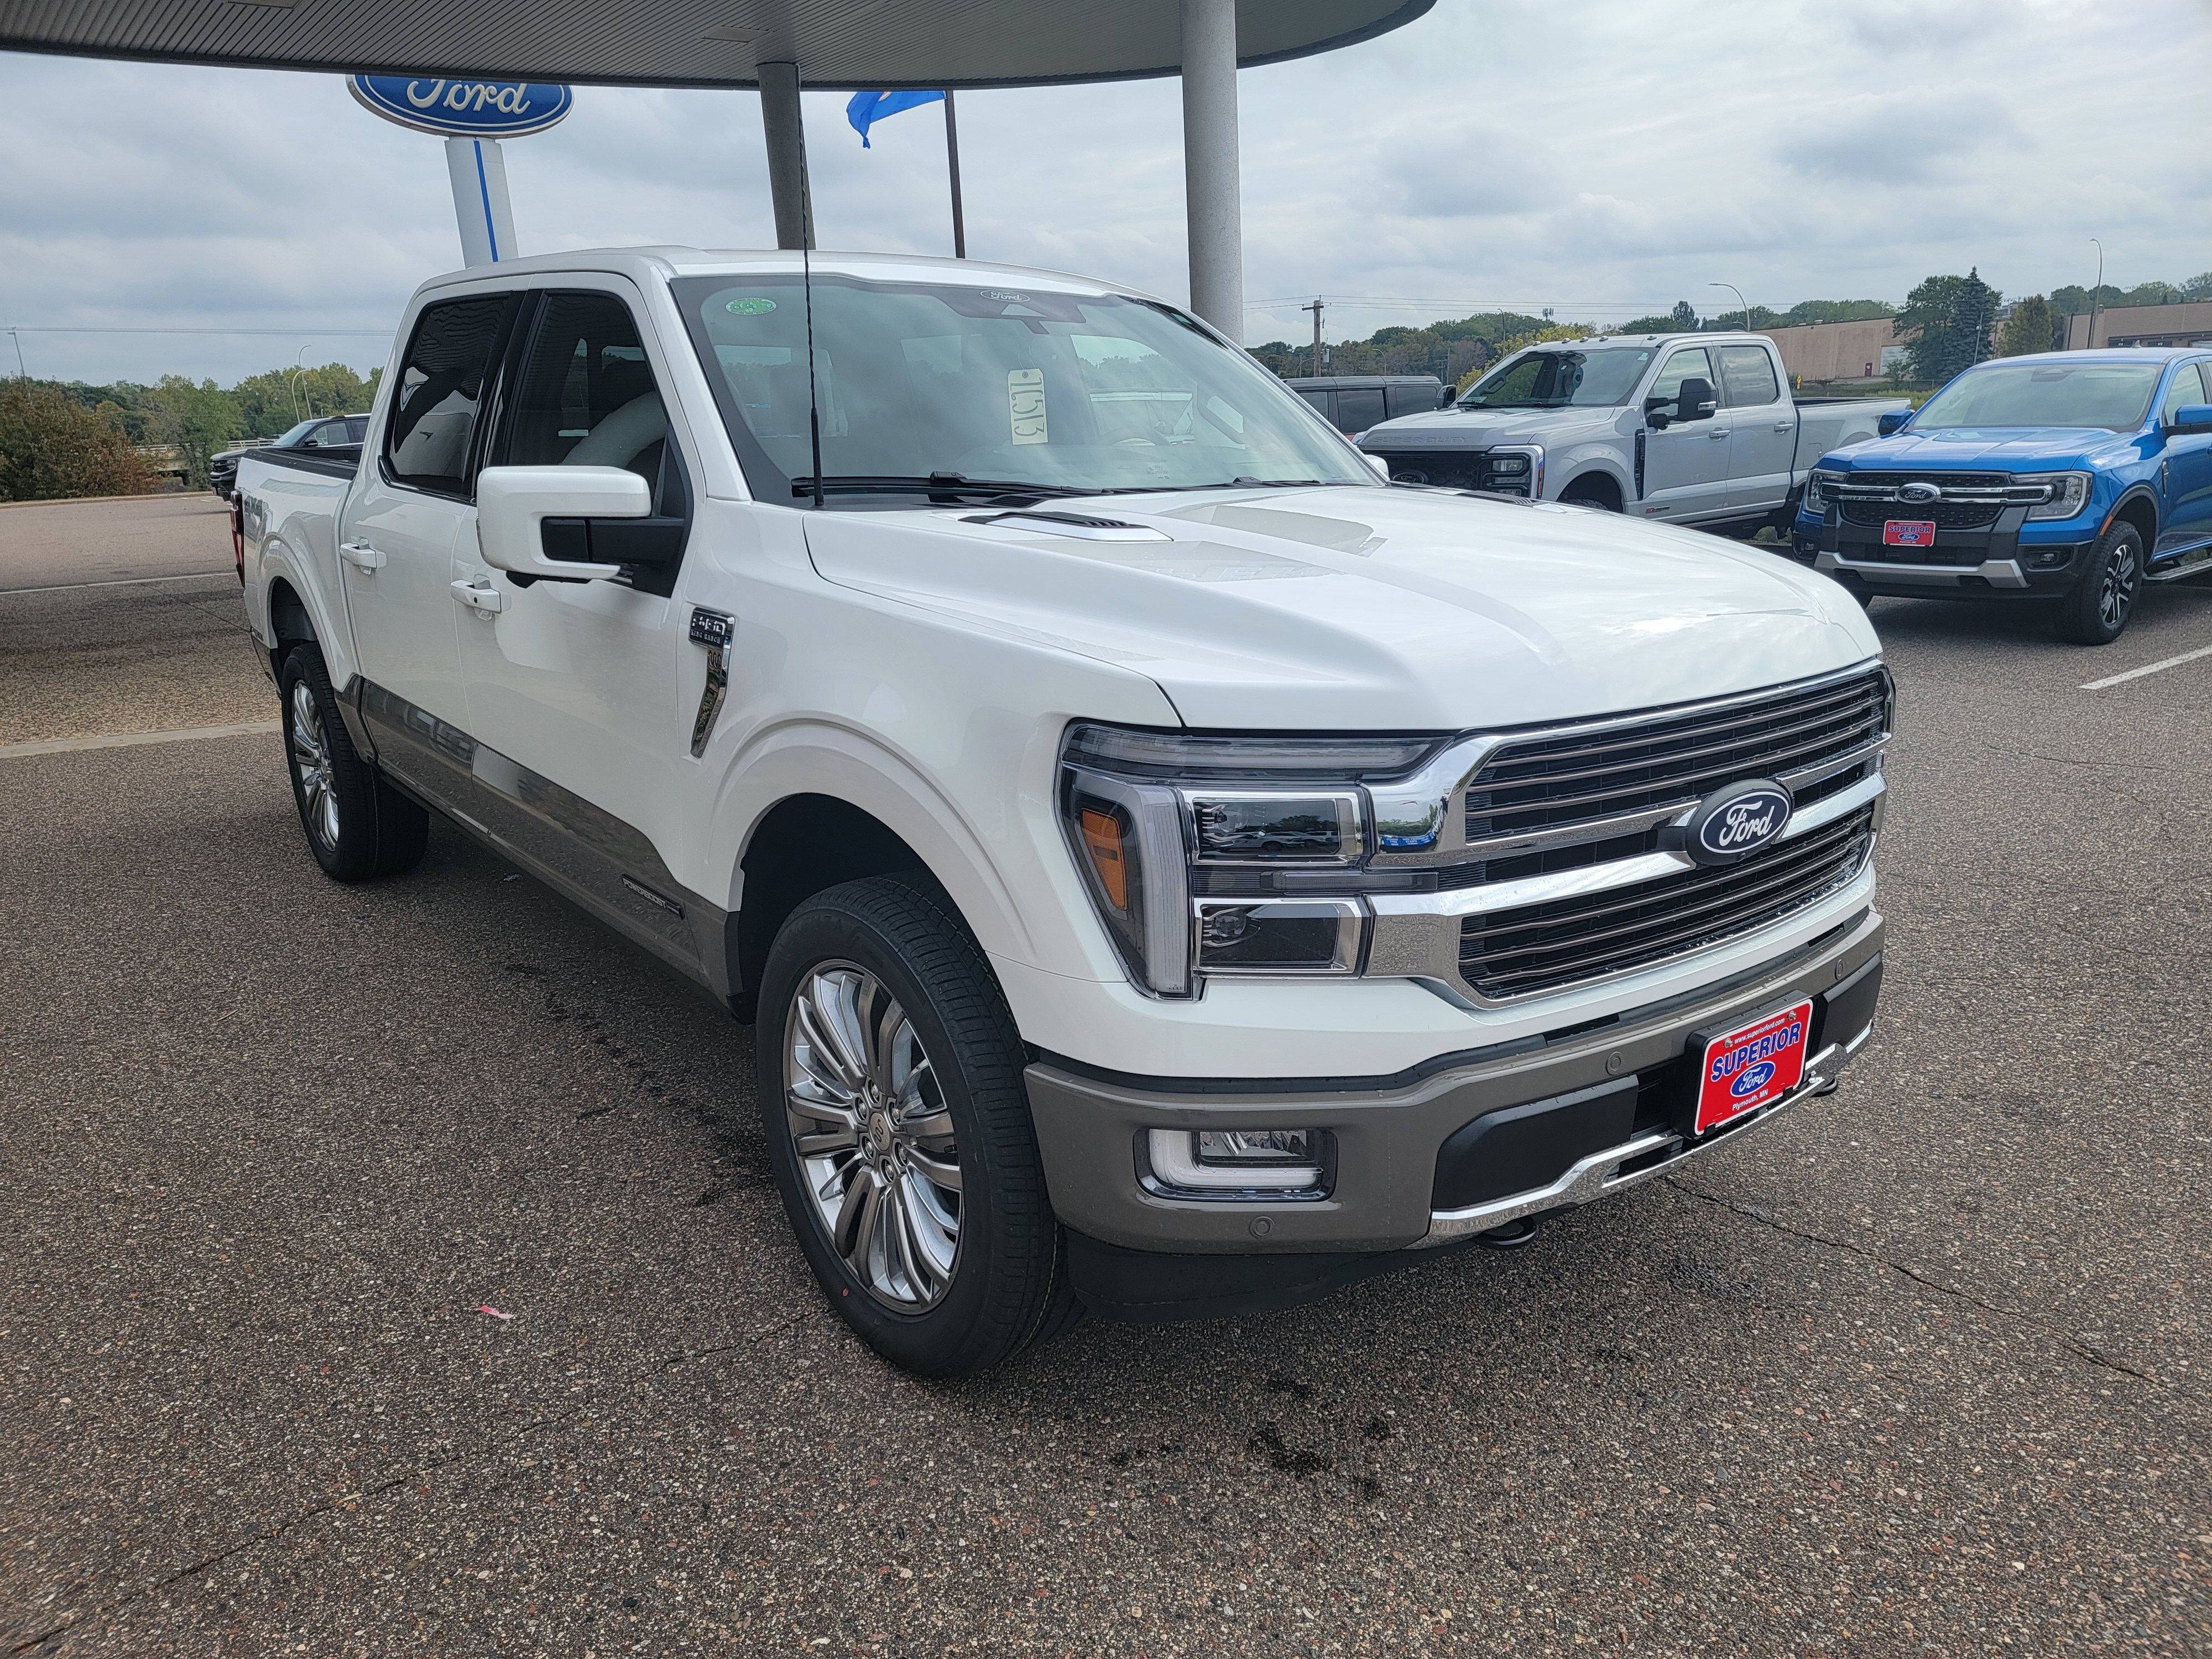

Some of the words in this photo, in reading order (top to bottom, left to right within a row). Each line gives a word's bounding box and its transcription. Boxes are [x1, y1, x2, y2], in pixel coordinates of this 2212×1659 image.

[990, 291, 1022, 301] Ford
[1905, 489, 1927, 499] Ford
[1888, 525, 1931, 534] SUPERIOR
[690, 629, 703, 638] KING
[704, 633, 721, 645] RANCH
[1719, 800, 1775, 847] Ford
[1734, 1017, 1785, 1045] www.superiorford.com
[1710, 1021, 1802, 1082] SUPERIOR
[1739, 1066, 1768, 1093] Ford
[1732, 1094, 1759, 1112] Plymouth,
[1759, 1088, 1768, 1099] MN
